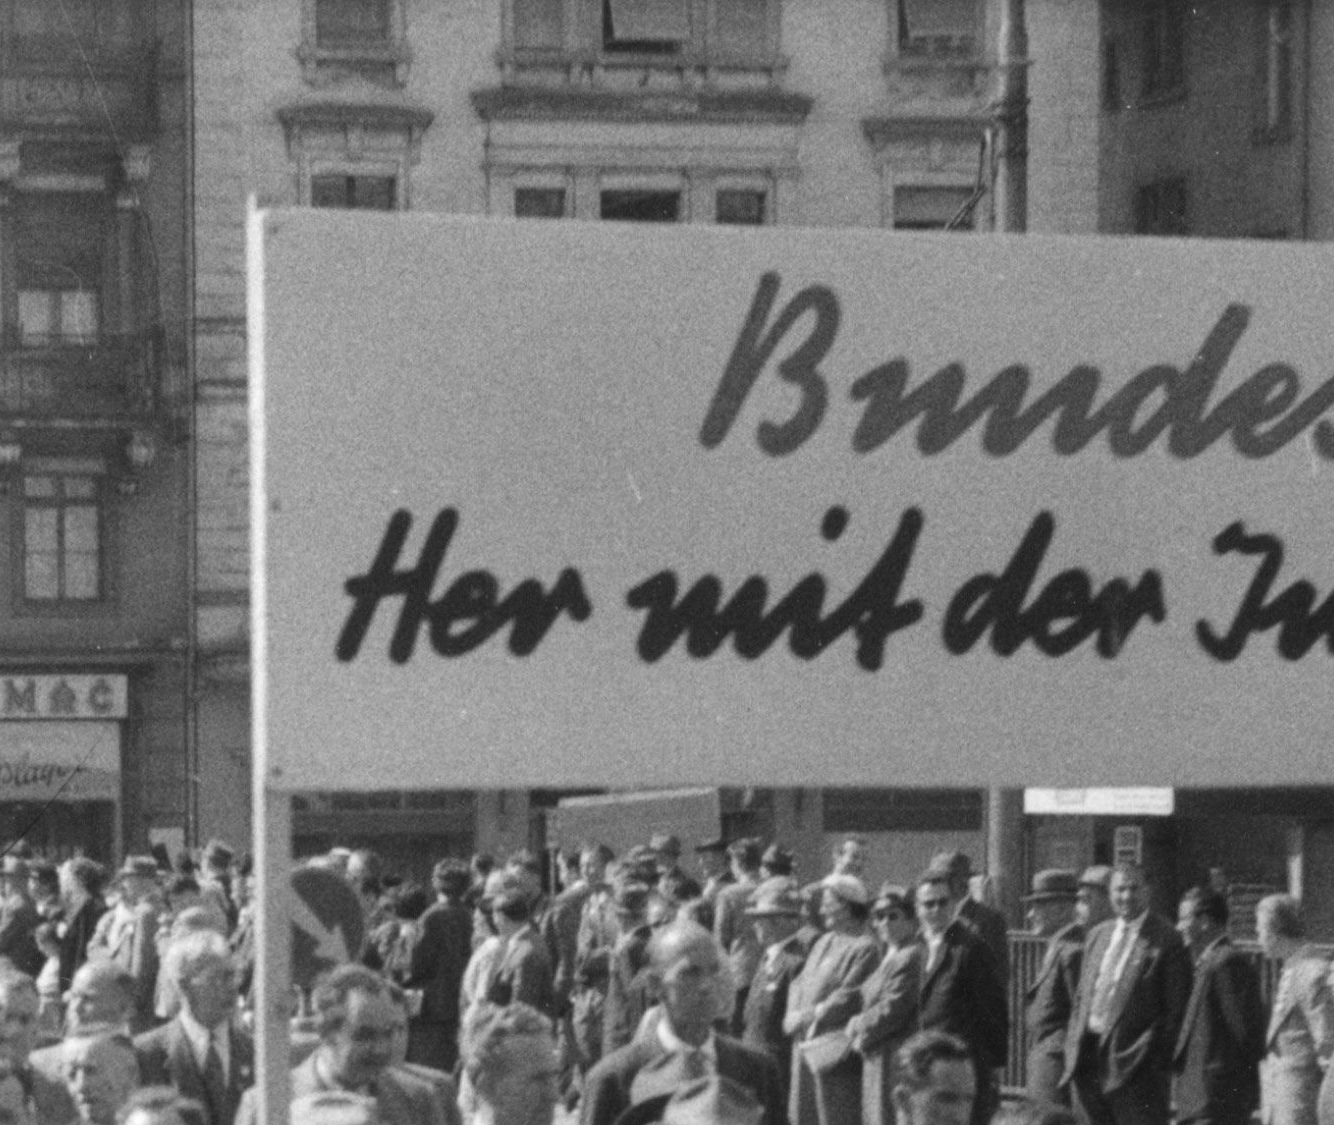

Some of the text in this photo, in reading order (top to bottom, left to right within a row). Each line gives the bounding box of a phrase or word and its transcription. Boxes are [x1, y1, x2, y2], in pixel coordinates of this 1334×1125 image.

[334, 506, 592, 664] Her
[627, 504, 924, 672] mit
[942, 509, 1167, 659] der
